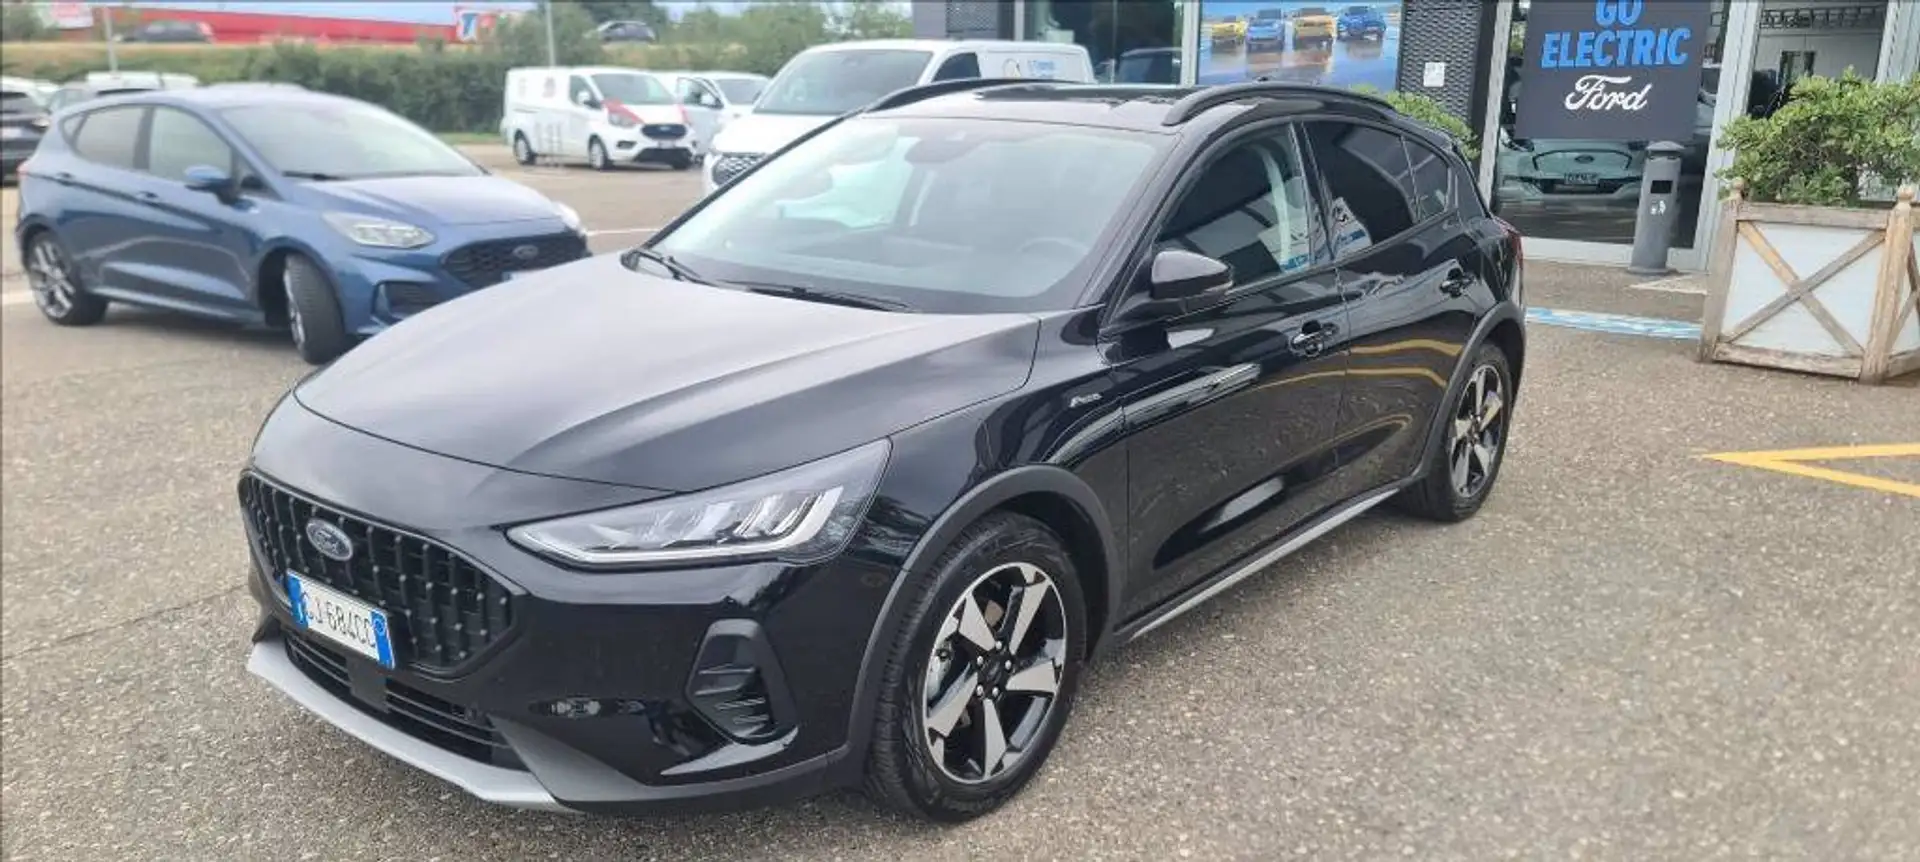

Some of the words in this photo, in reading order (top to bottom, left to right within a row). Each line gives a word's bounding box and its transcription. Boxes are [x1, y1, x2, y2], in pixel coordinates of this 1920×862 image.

[1595, 0, 1643, 27] GO
[1541, 28, 1691, 68] ELECTRIC
[1564, 74, 1653, 112] Ford
